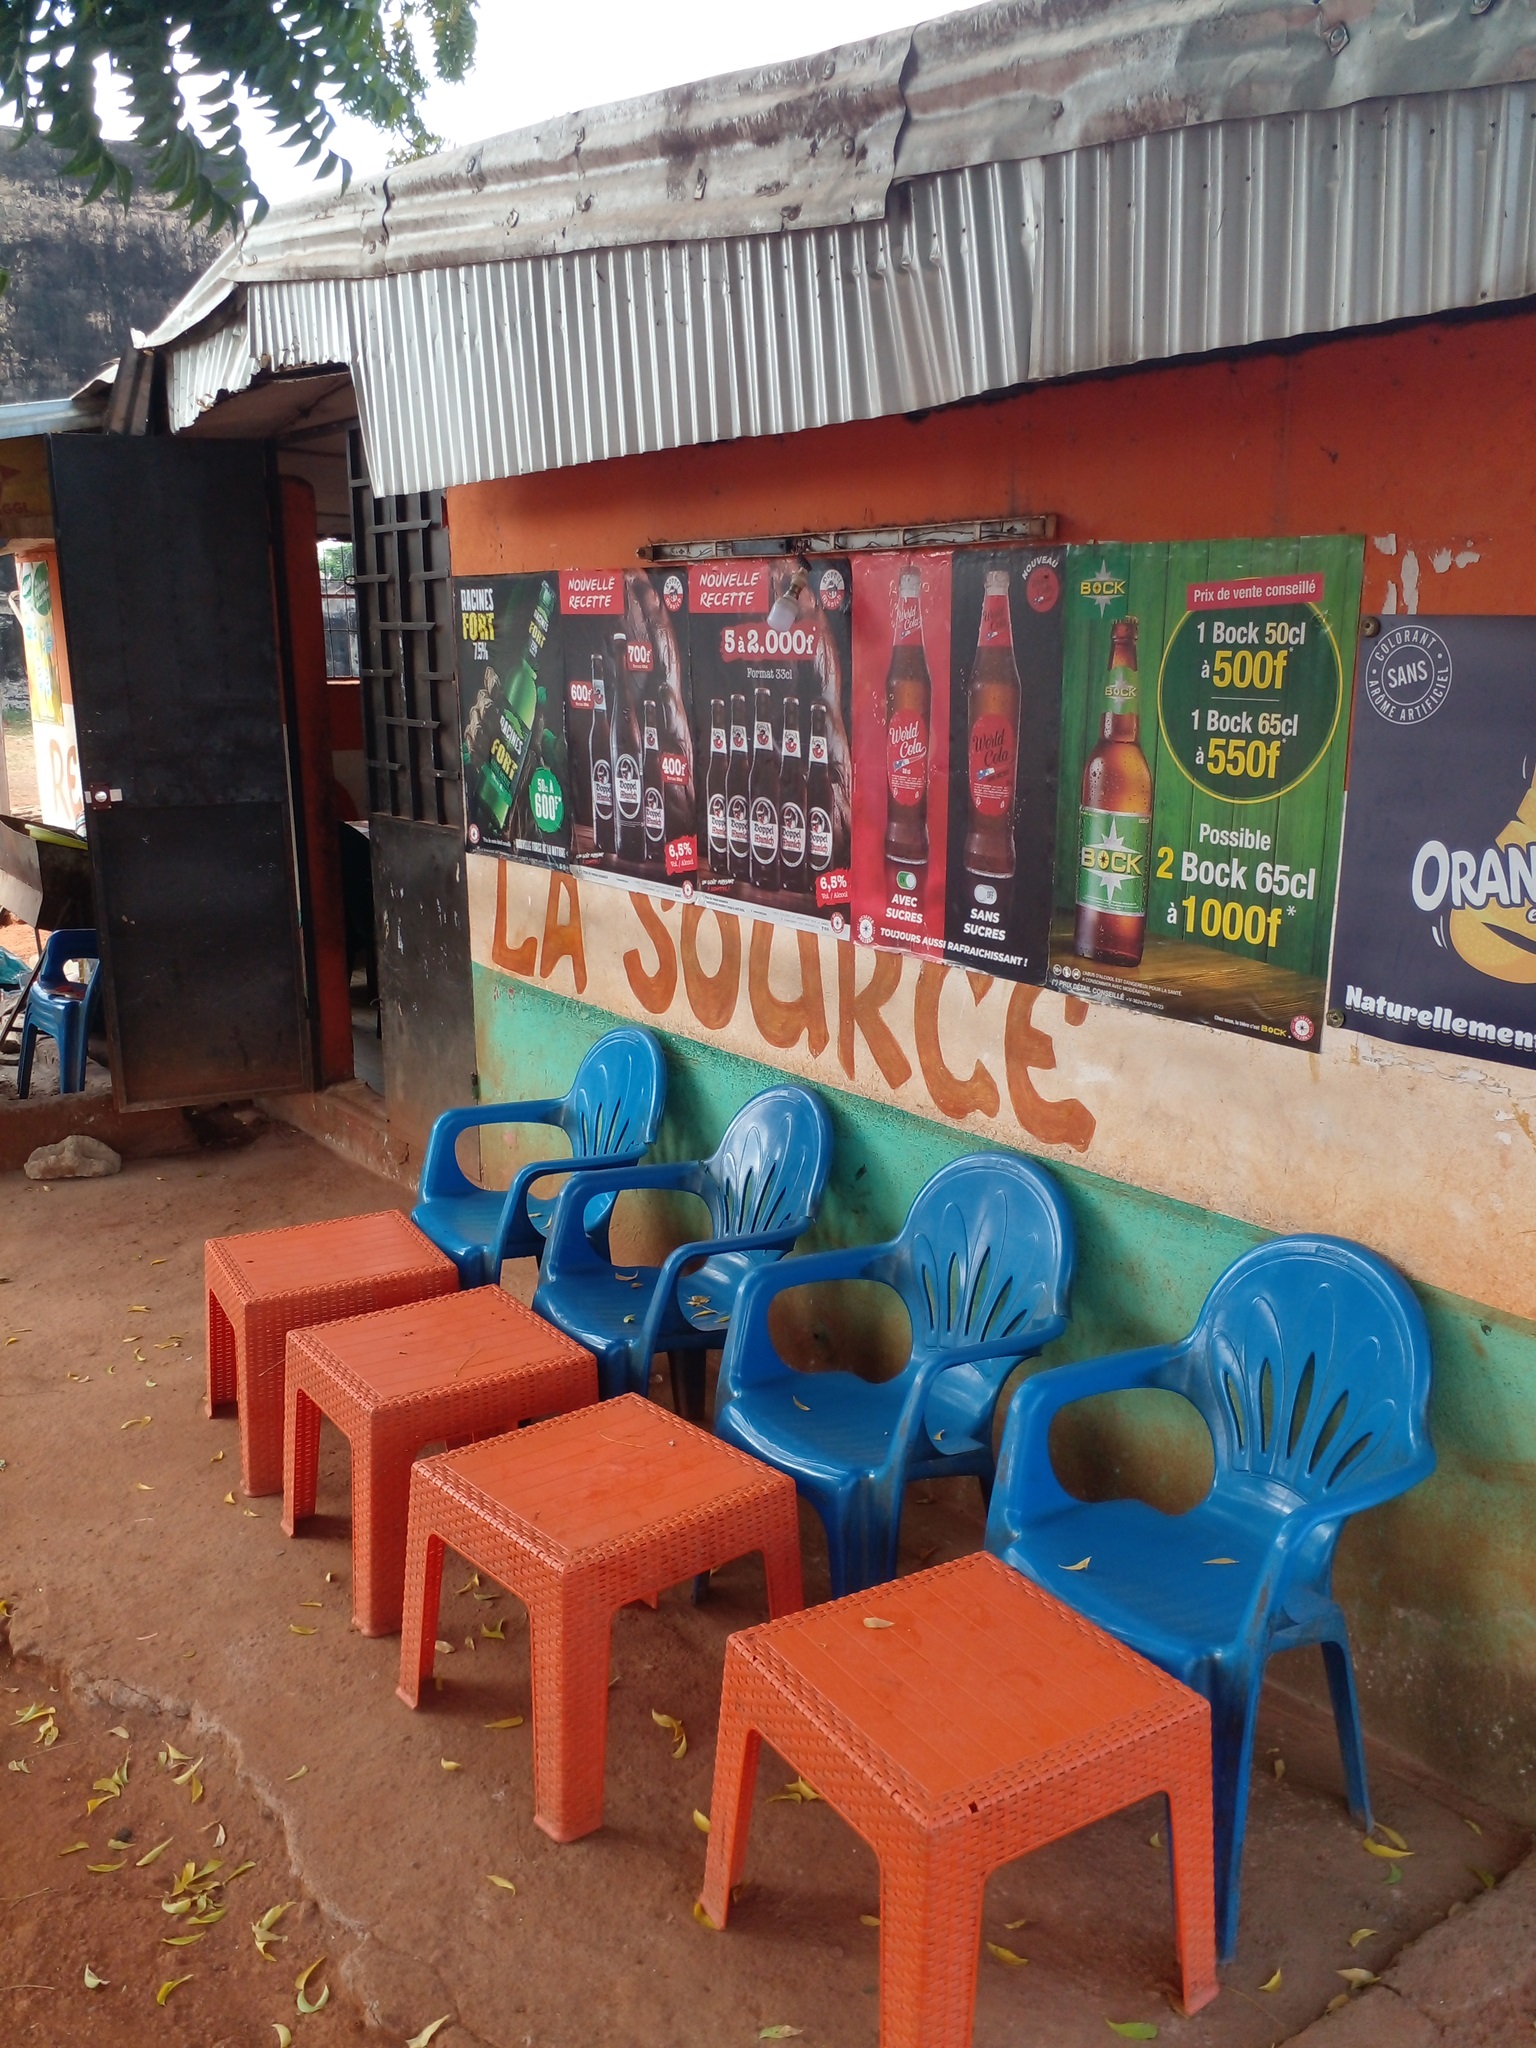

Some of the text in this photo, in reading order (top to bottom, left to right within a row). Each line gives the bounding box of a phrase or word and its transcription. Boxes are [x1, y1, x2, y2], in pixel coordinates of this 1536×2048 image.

[0, 502, 28, 517] GGI
[700, 571, 760, 588] NOUVELLE
[1022, 556, 1059, 580] NOUVEAU
[568, 577, 615, 592] NOUVELLE
[1080, 581, 1126, 596] BOCK
[1194, 579, 1316, 602] Prix de vente conseillé
[460, 588, 494, 611] RACINES
[569, 595, 612, 609] RECETTE
[700, 592, 754, 608] RECETTE
[462, 612, 495, 641] FORT
[528, 620, 547, 649] FORT
[1197, 622, 1306, 645] 1 Bock 50cl
[724, 629, 735, 653] 5
[738, 636, 746, 654] à
[1374, 629, 1437, 662] COLORANT
[747, 667, 793, 680] Format 33cl
[1201, 660, 1210, 679] à
[1387, 660, 1428, 688] SANS
[1105, 686, 1137, 697] BOCK
[1368, 666, 1450, 722] ARÔME ARTIFICIEL
[890, 721, 919, 745] World
[1191, 709, 1299, 736] 1 Bock 65cl
[500, 715, 523, 755] RACINES
[973, 729, 1005, 752] World
[490, 738, 519, 780] FORT
[900, 738, 926, 759] Cola
[984, 747, 1009, 767] Cola
[1195, 746, 1204, 765] à
[754, 823, 774, 835] Doppel
[1199, 823, 1271, 851] Possible
[668, 842, 692, 860] 6,5%
[1081, 847, 1144, 876] BOCK
[820, 875, 847, 892] 6,5%
[1156, 846, 1316, 900] 2 Bock 65cl
[891, 893, 918, 907] AVEC
[886, 907, 923, 924] SUCRES
[970, 908, 1000, 924] SANS
[1166, 902, 1178, 925] à
[963, 923, 1006, 942] SUCRES
[880, 927, 921, 944] TOUJOURS
[922, 936, 947, 950] AUSSI
[947, 941, 1023, 967] RAFRAICHISSANT
[1058, 979, 1073, 989] PRIX
[1073, 981, 1091, 994] DÉTAIL
[1092, 987, 1125, 1001] CONSEILLÉ
[491, 858, 1097, 1153] LA SOURCE
